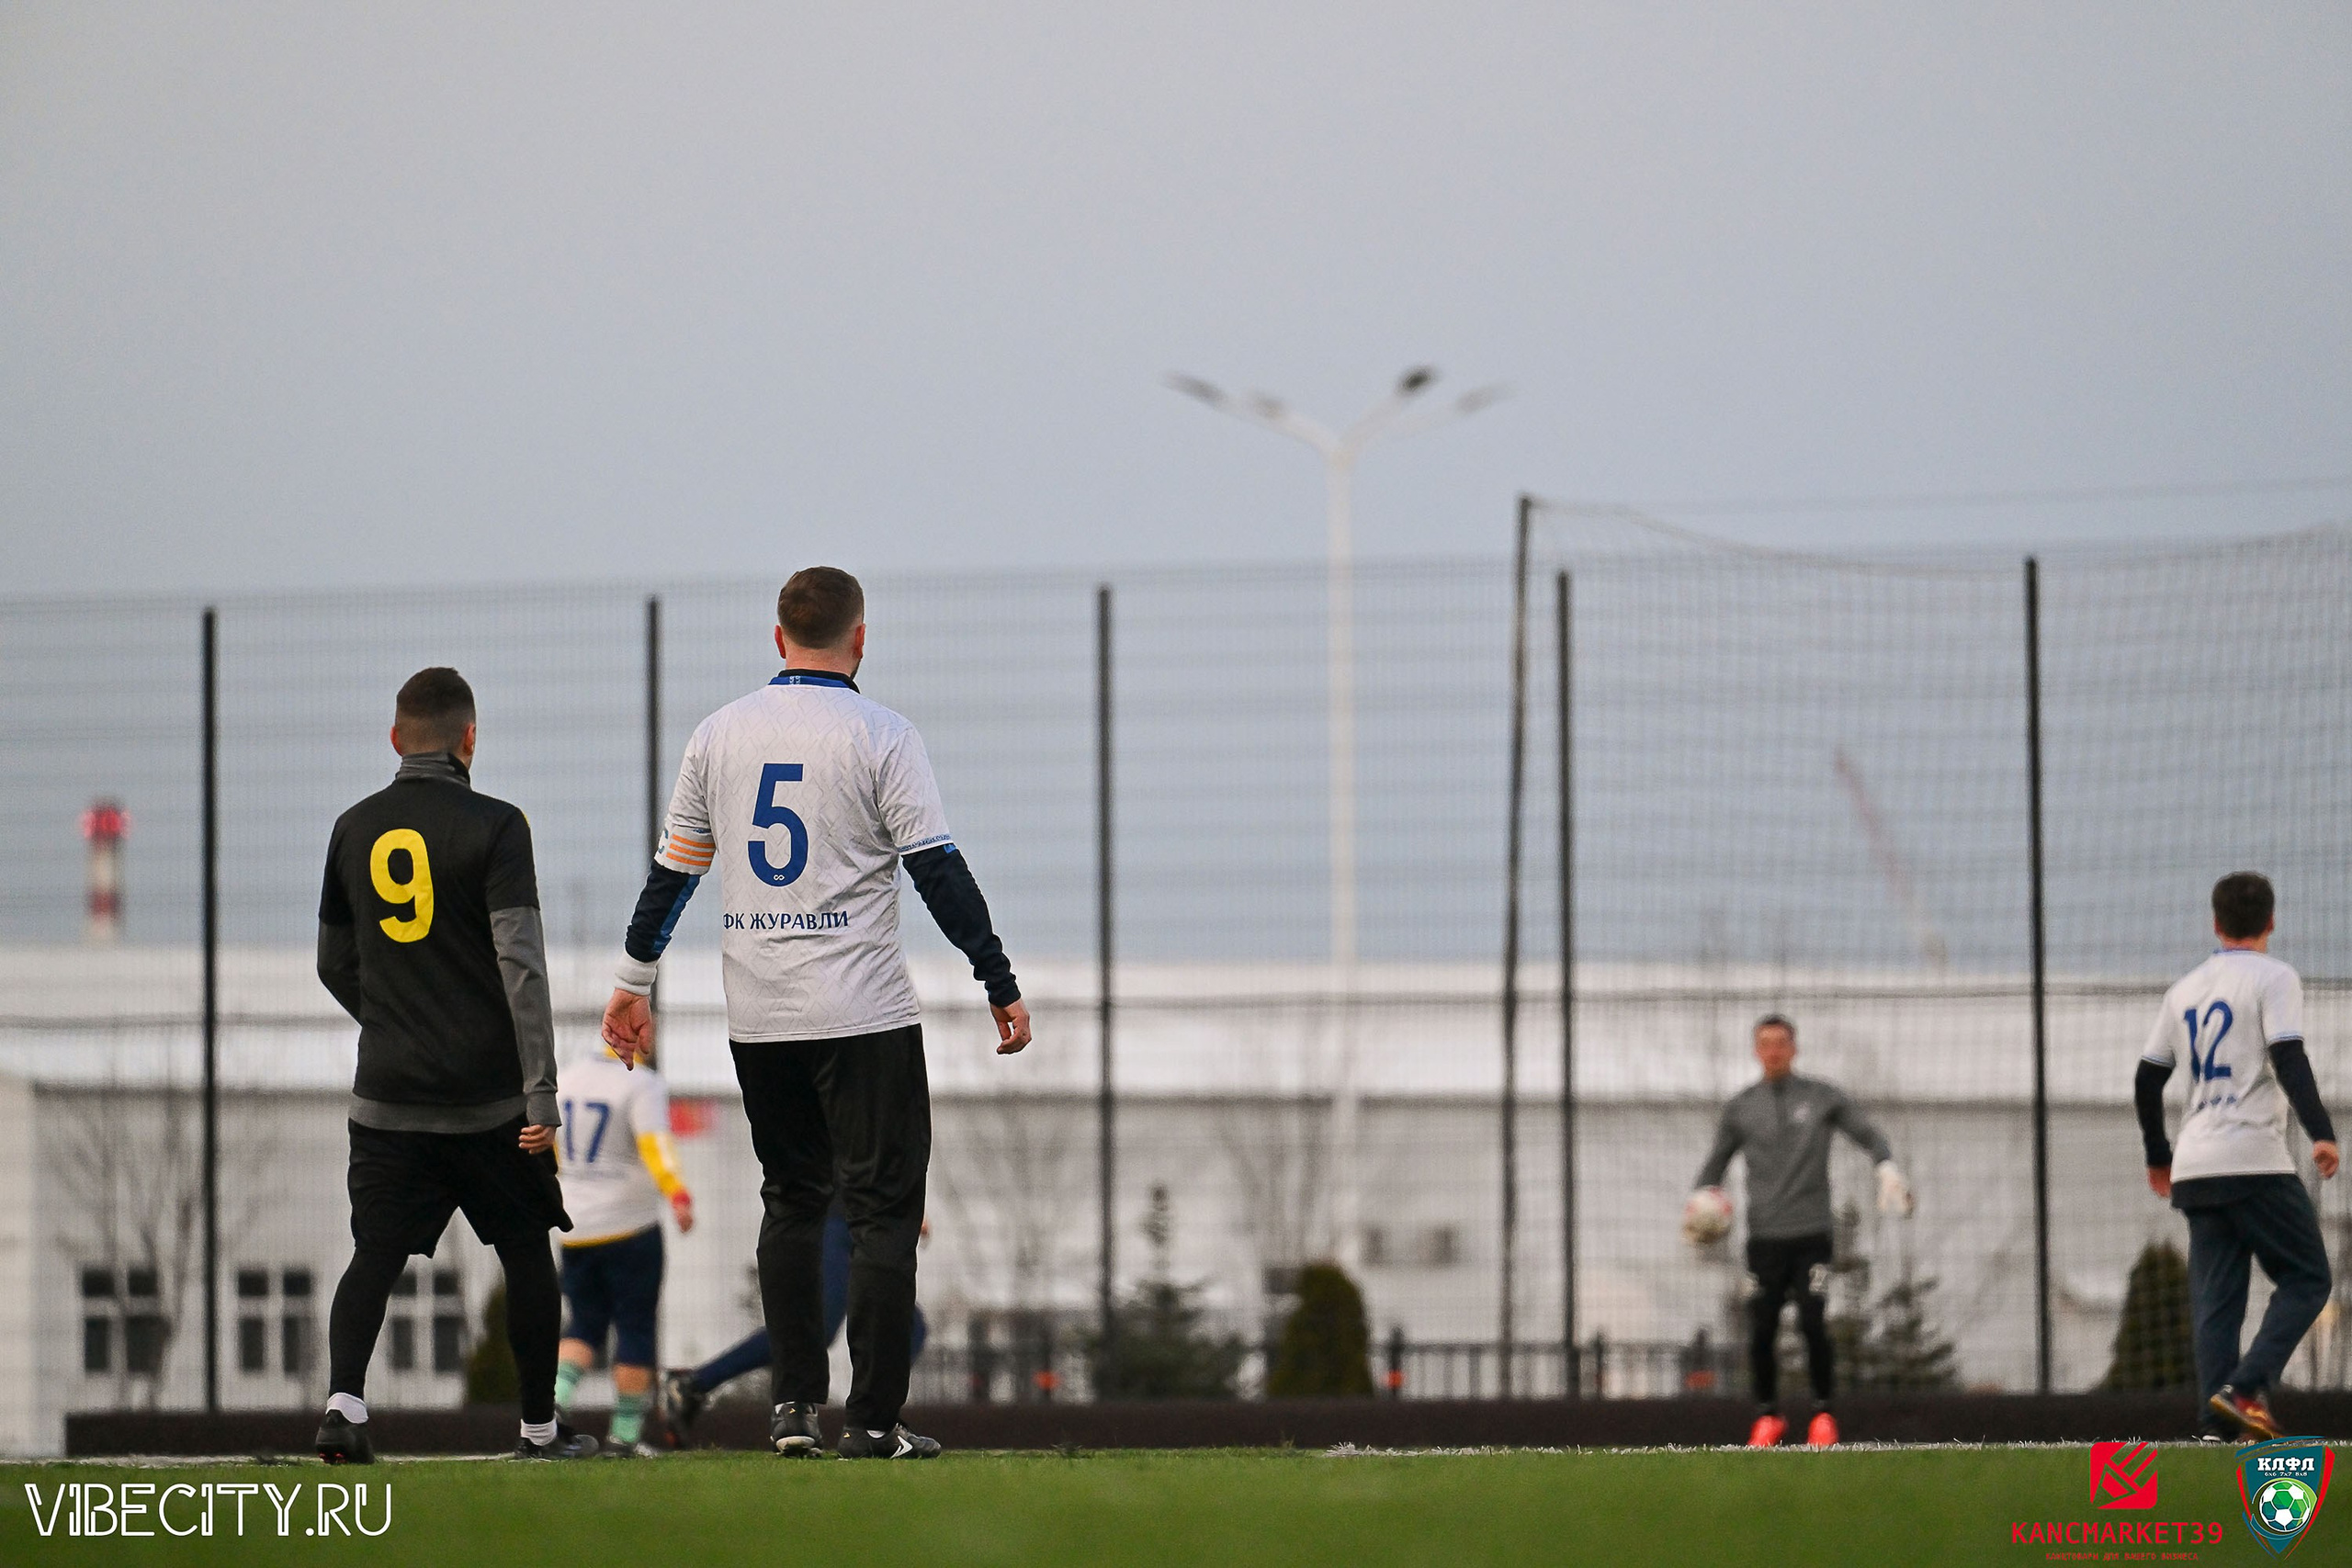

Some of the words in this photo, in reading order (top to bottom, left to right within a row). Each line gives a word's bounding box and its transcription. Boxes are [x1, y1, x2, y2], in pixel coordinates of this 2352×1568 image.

[748, 763, 808, 887] 5
[370, 829, 434, 943] 9
[723, 913, 745, 930] ФК
[750, 910, 848, 930] ЖУРАВЛИ
[2184, 1000, 2233, 1082] 12
[564, 1100, 609, 1163] 17
